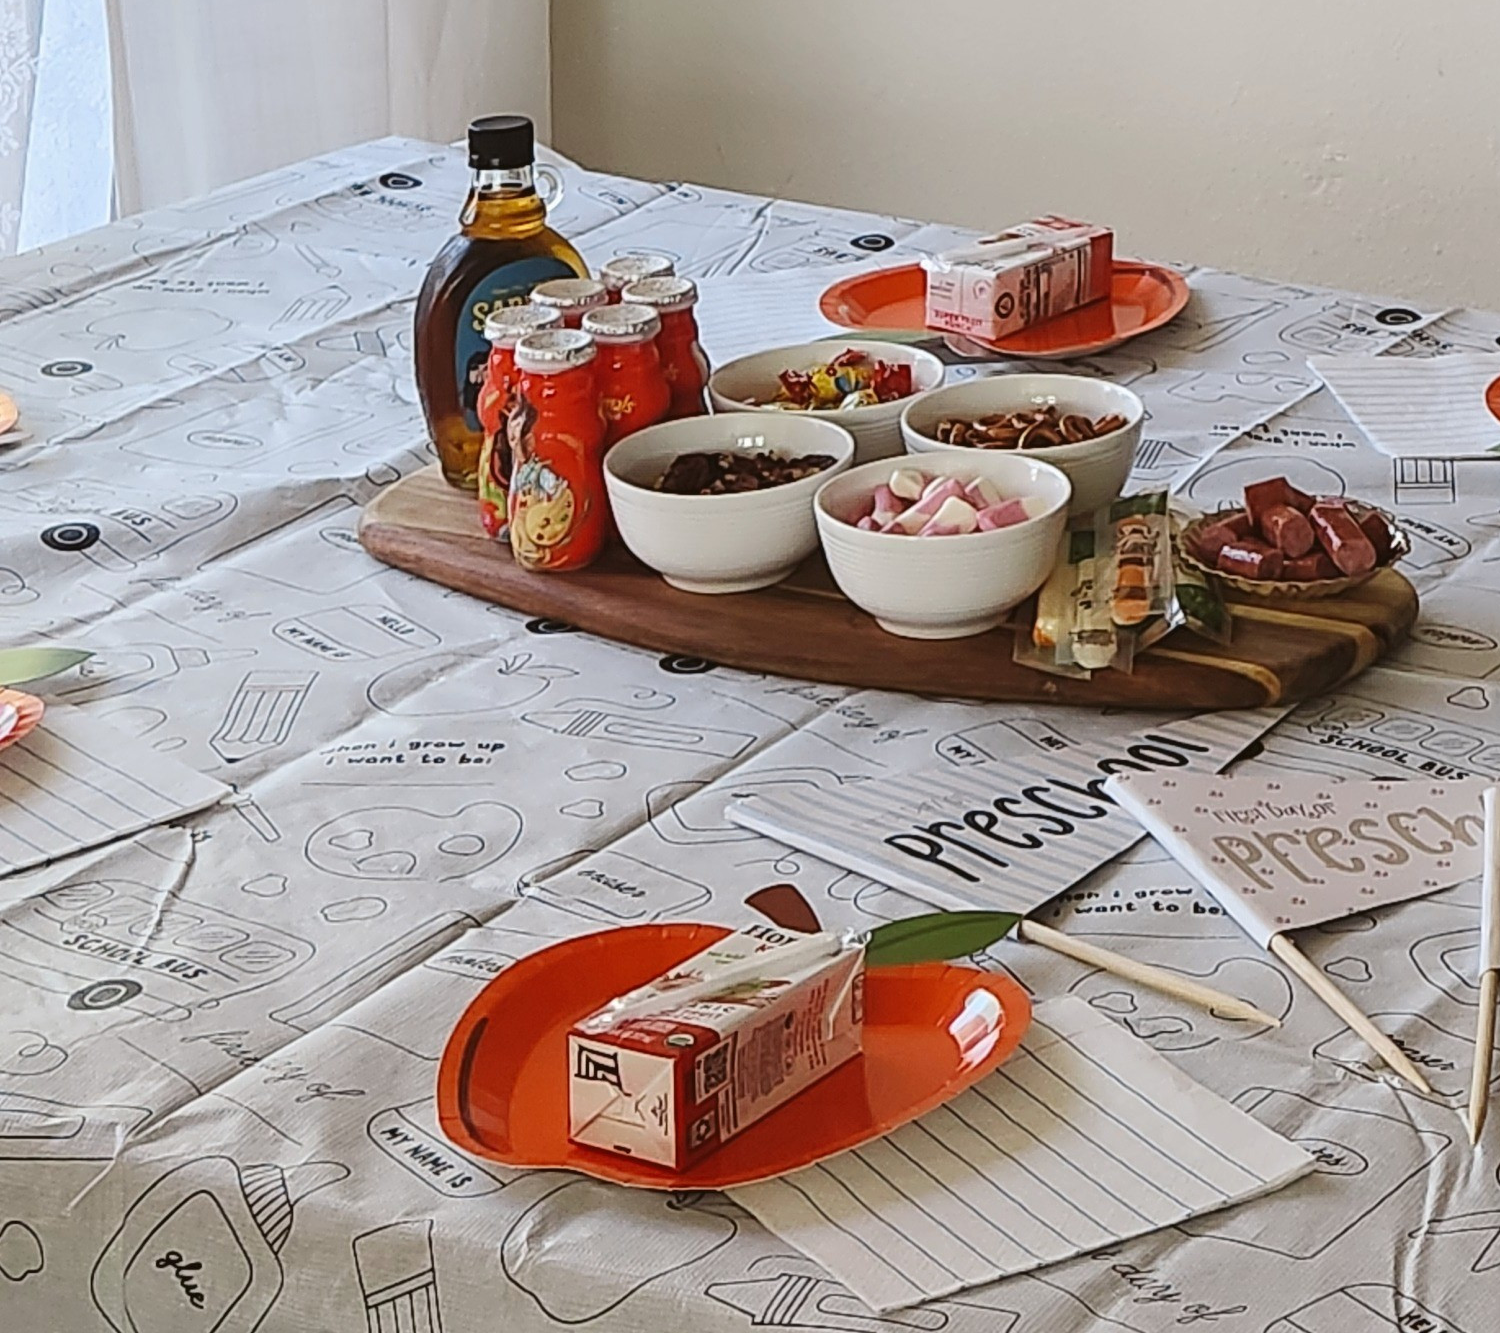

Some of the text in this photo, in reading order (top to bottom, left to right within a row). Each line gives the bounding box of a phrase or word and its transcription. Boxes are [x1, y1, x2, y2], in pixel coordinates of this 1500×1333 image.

[347, 753, 407, 764] want
[421, 753, 446, 764] to
[408, 740, 466, 751] grow
[477, 742, 507, 753] up
[1319, 734, 1470, 780] SCHOOL BUS
[1074, 902, 1138, 916] want
[1151, 900, 1180, 913] to
[1133, 887, 1194, 901] grow
[62, 934, 209, 980] SCHOOL BUS
[379, 1126, 473, 1190] MY NAME IS
[155, 1250, 206, 1310] glue
